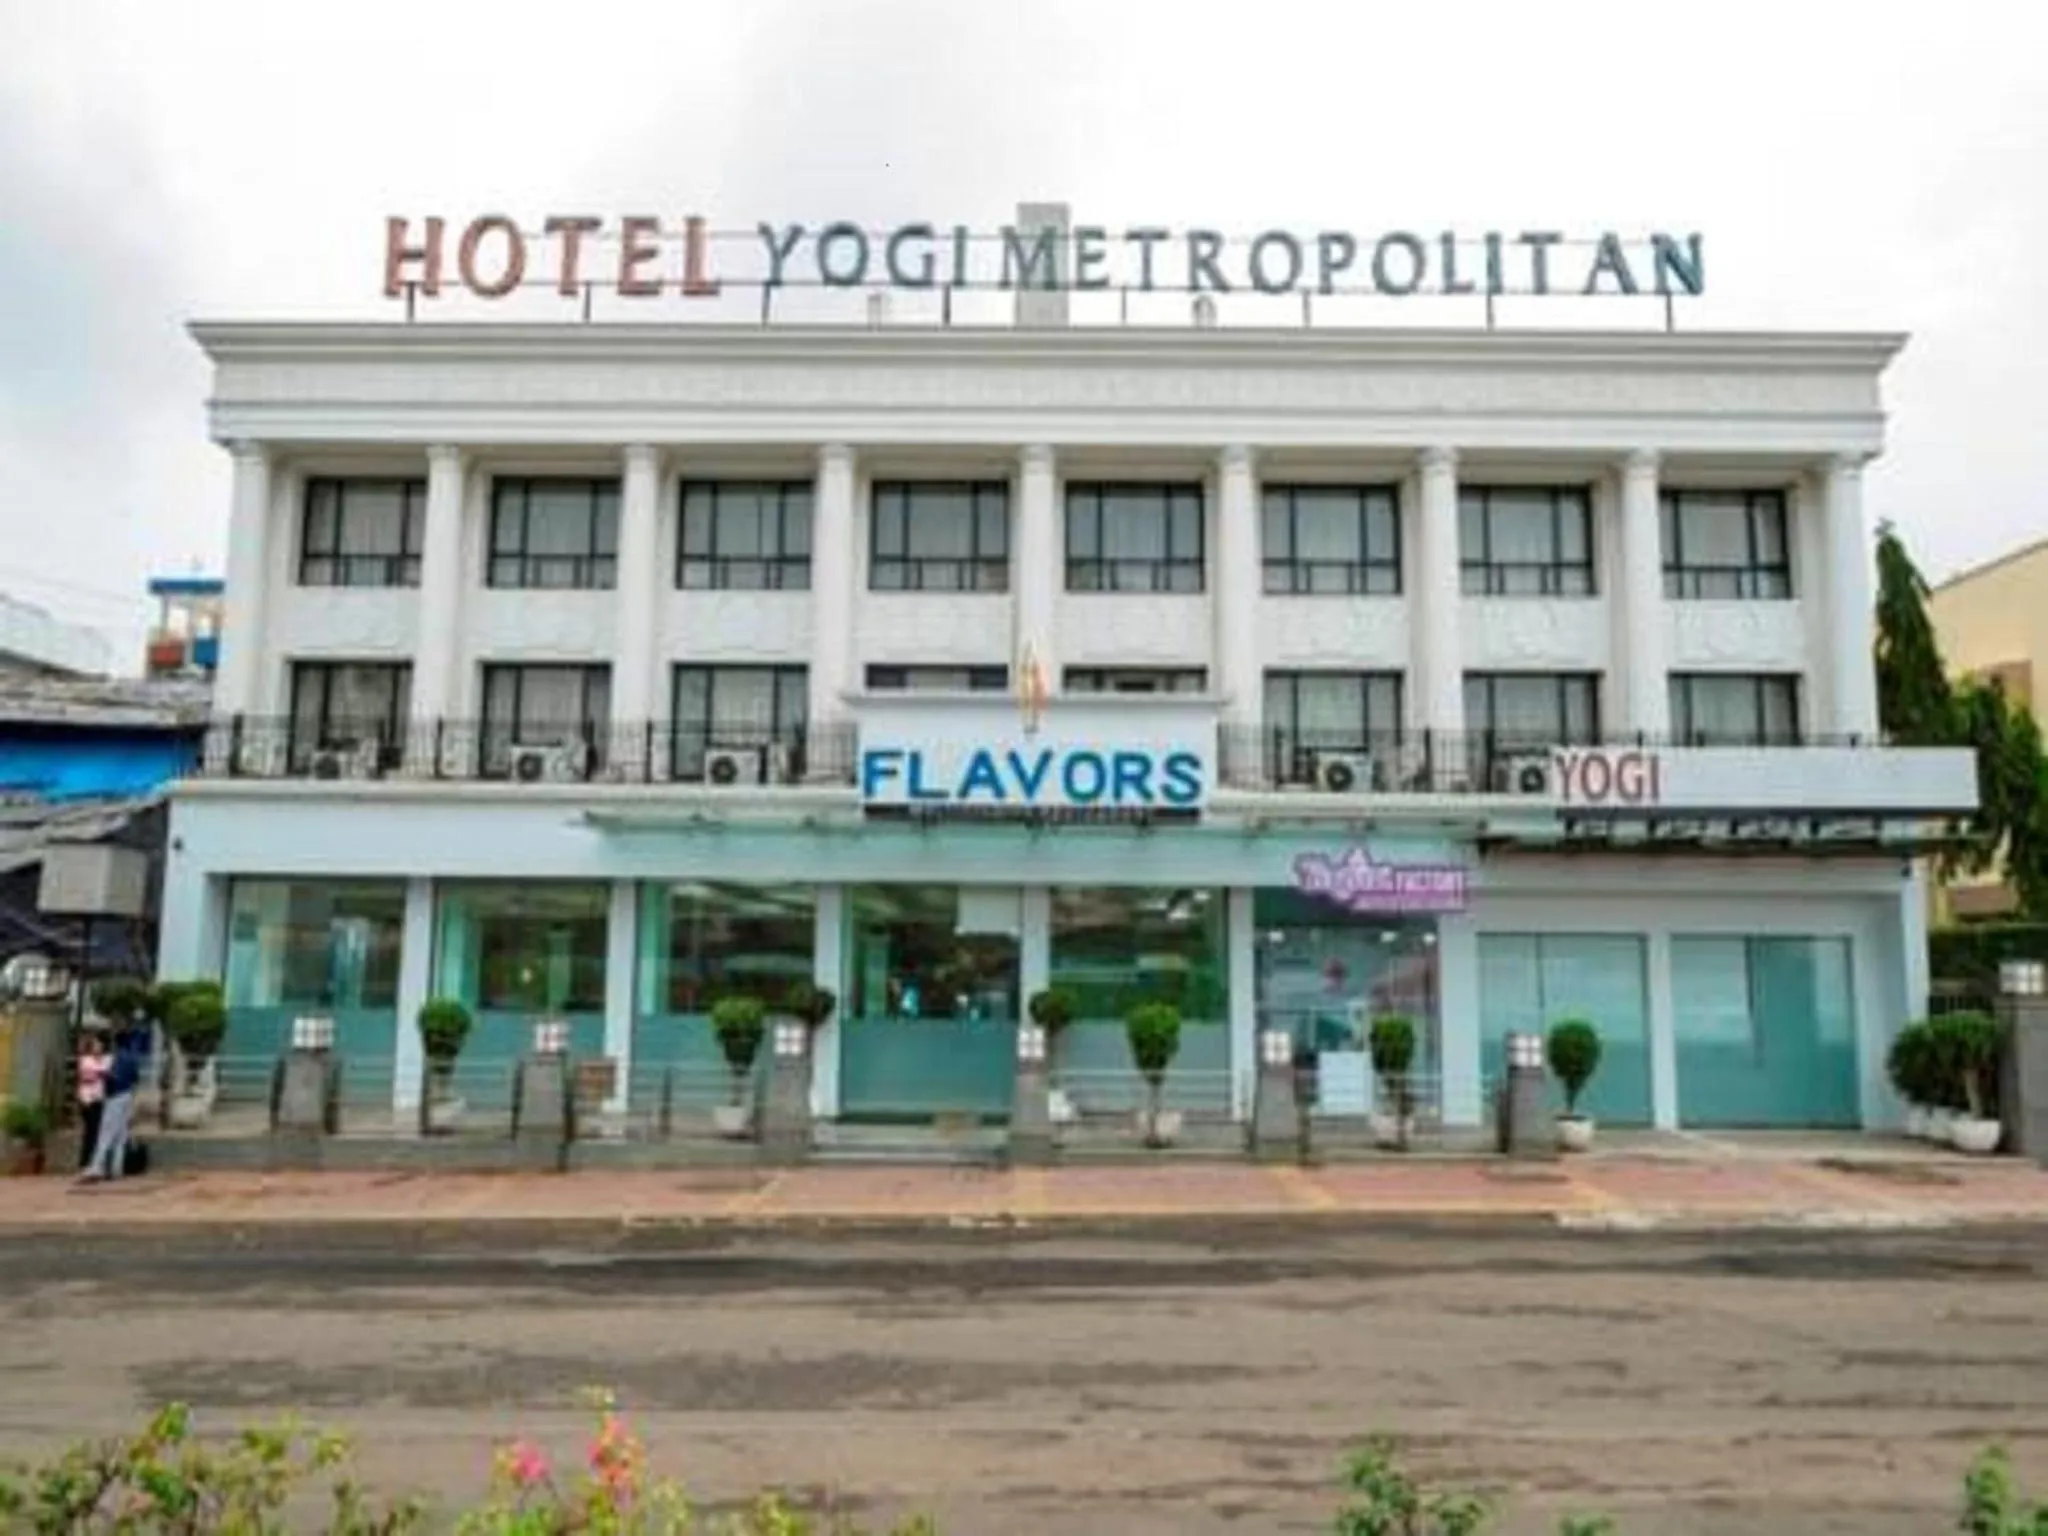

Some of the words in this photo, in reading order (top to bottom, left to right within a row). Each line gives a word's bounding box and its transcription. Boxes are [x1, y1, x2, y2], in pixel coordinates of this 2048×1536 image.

[384, 216, 721, 298] HOTEL
[757, 221, 968, 288] YOGI
[998, 224, 1705, 296] METROPOLITAN
[863, 748, 1203, 804] FLAVORS
[1555, 752, 1661, 803] YOGI
